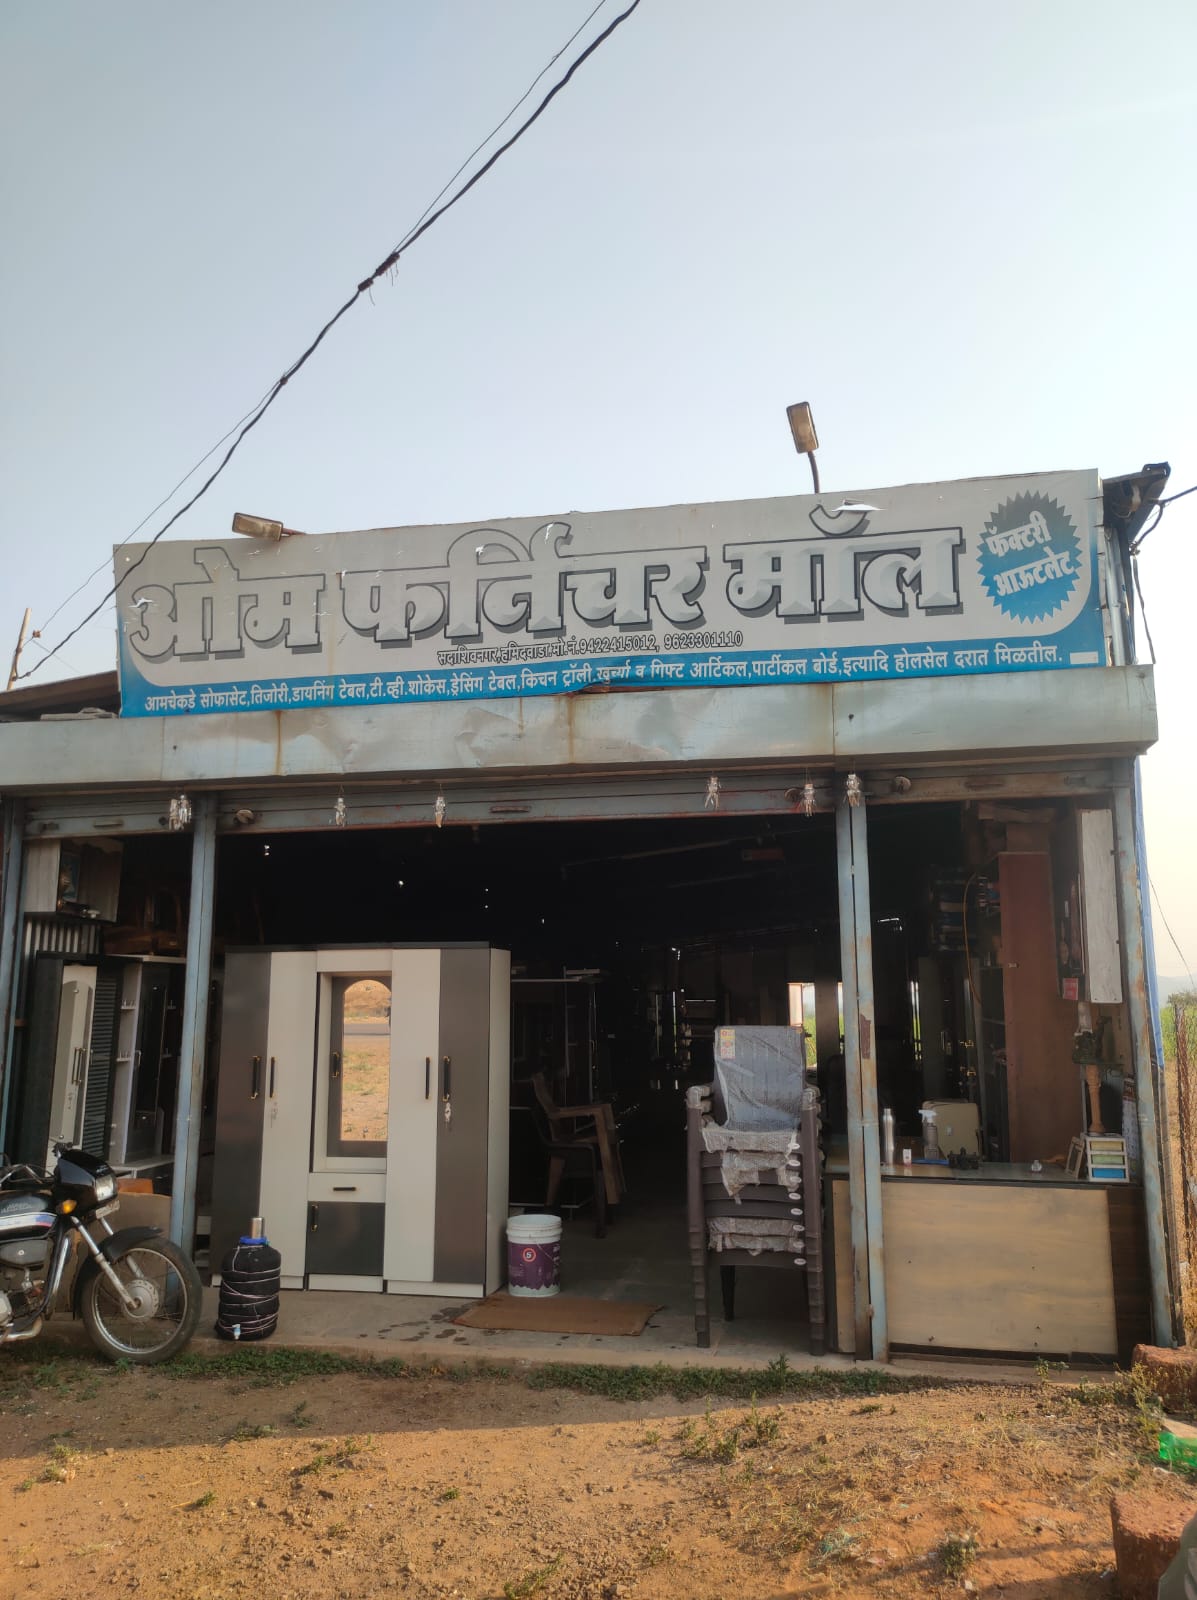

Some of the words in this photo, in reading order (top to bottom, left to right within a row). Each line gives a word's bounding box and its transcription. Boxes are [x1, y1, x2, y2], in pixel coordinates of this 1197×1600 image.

[985, 510, 1052, 557] फॅक्टरी
[129, 547, 326, 661] ओम
[340, 521, 709, 645] फर्निचर
[723, 504, 965, 622] मॉल
[993, 546, 1074, 597] आऊटलेट
[663, 630, 743, 650] 9623301110
[144, 688, 197, 711] आमचेकडे
[635, 665, 650, 678] व
[651, 658, 685, 679] गिफ्ट
[894, 646, 948, 671] होलसेल
[953, 649, 990, 668] दरात
[994, 639, 1063, 665] मिळतील.
